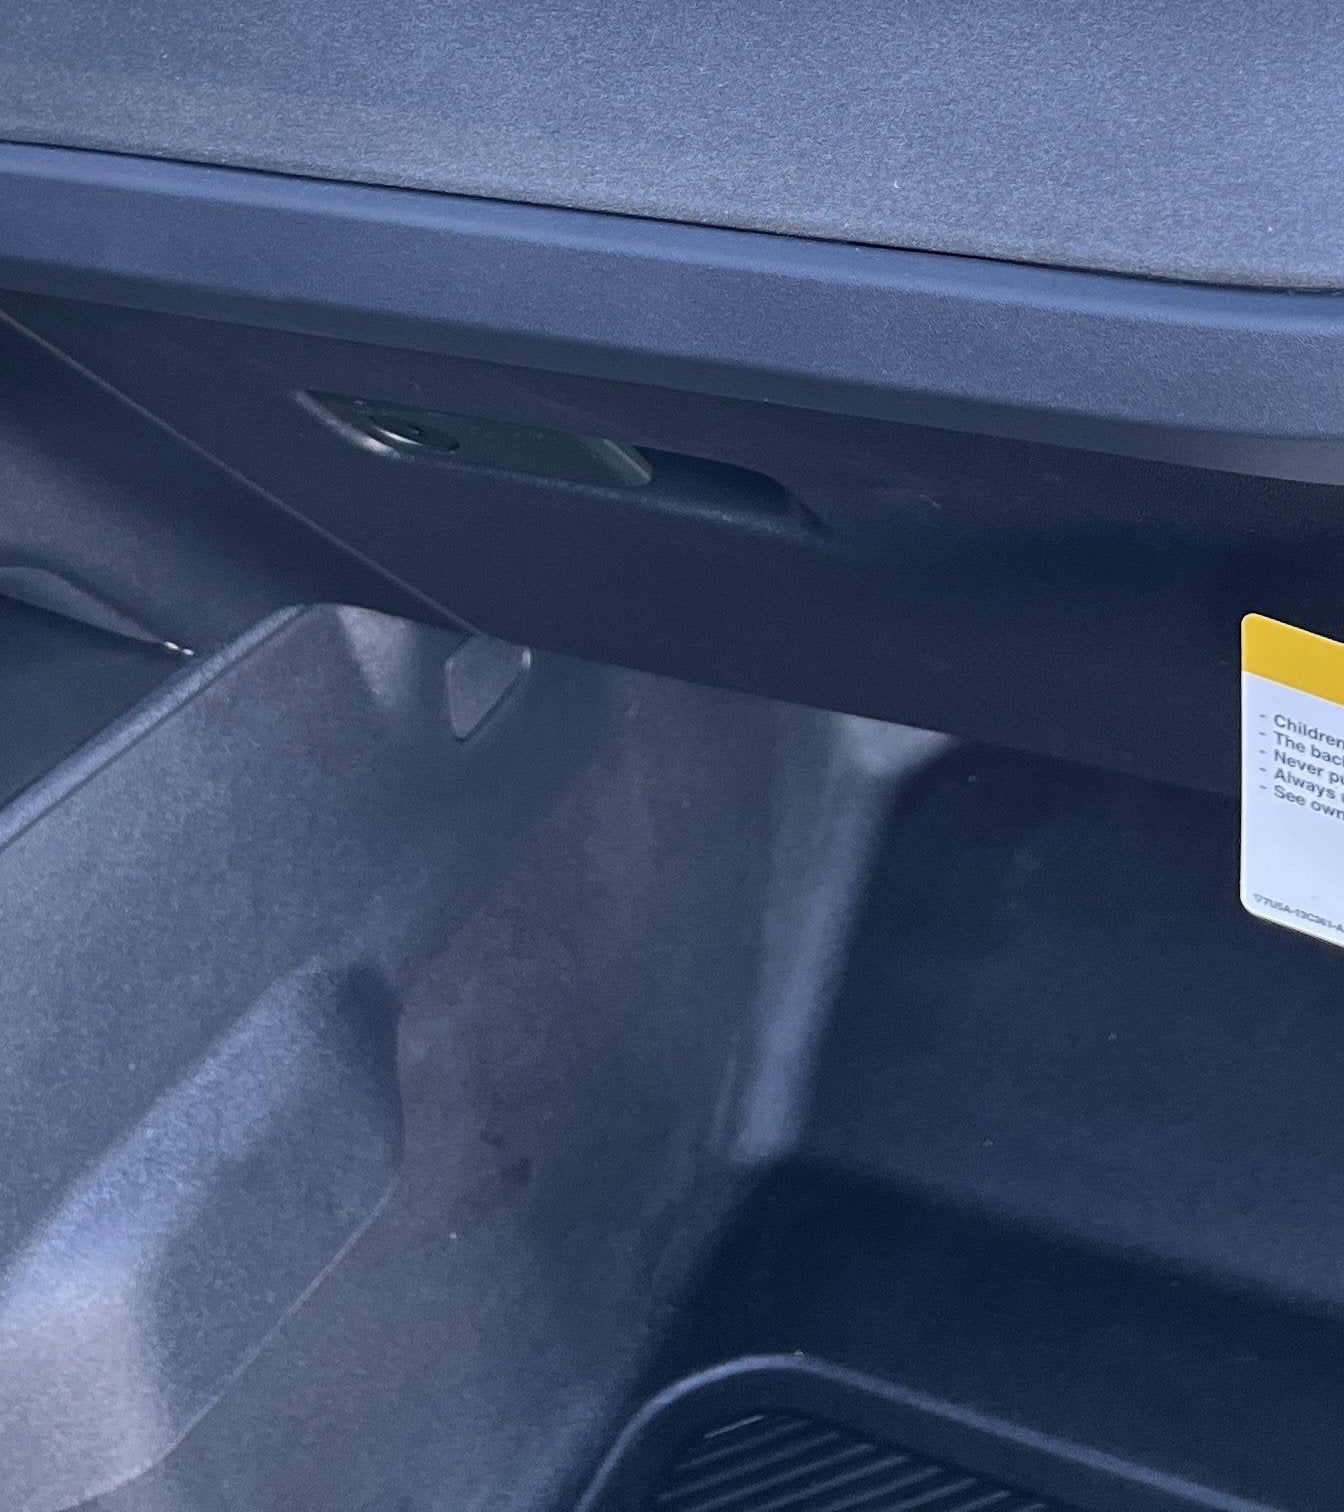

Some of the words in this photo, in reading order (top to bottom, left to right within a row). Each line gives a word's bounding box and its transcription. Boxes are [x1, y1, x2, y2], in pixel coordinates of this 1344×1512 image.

[1273, 731, 1305, 753] The
[1274, 749, 1325, 776] Never
[1274, 767, 1336, 799] Always
[1274, 784, 1306, 806] See
